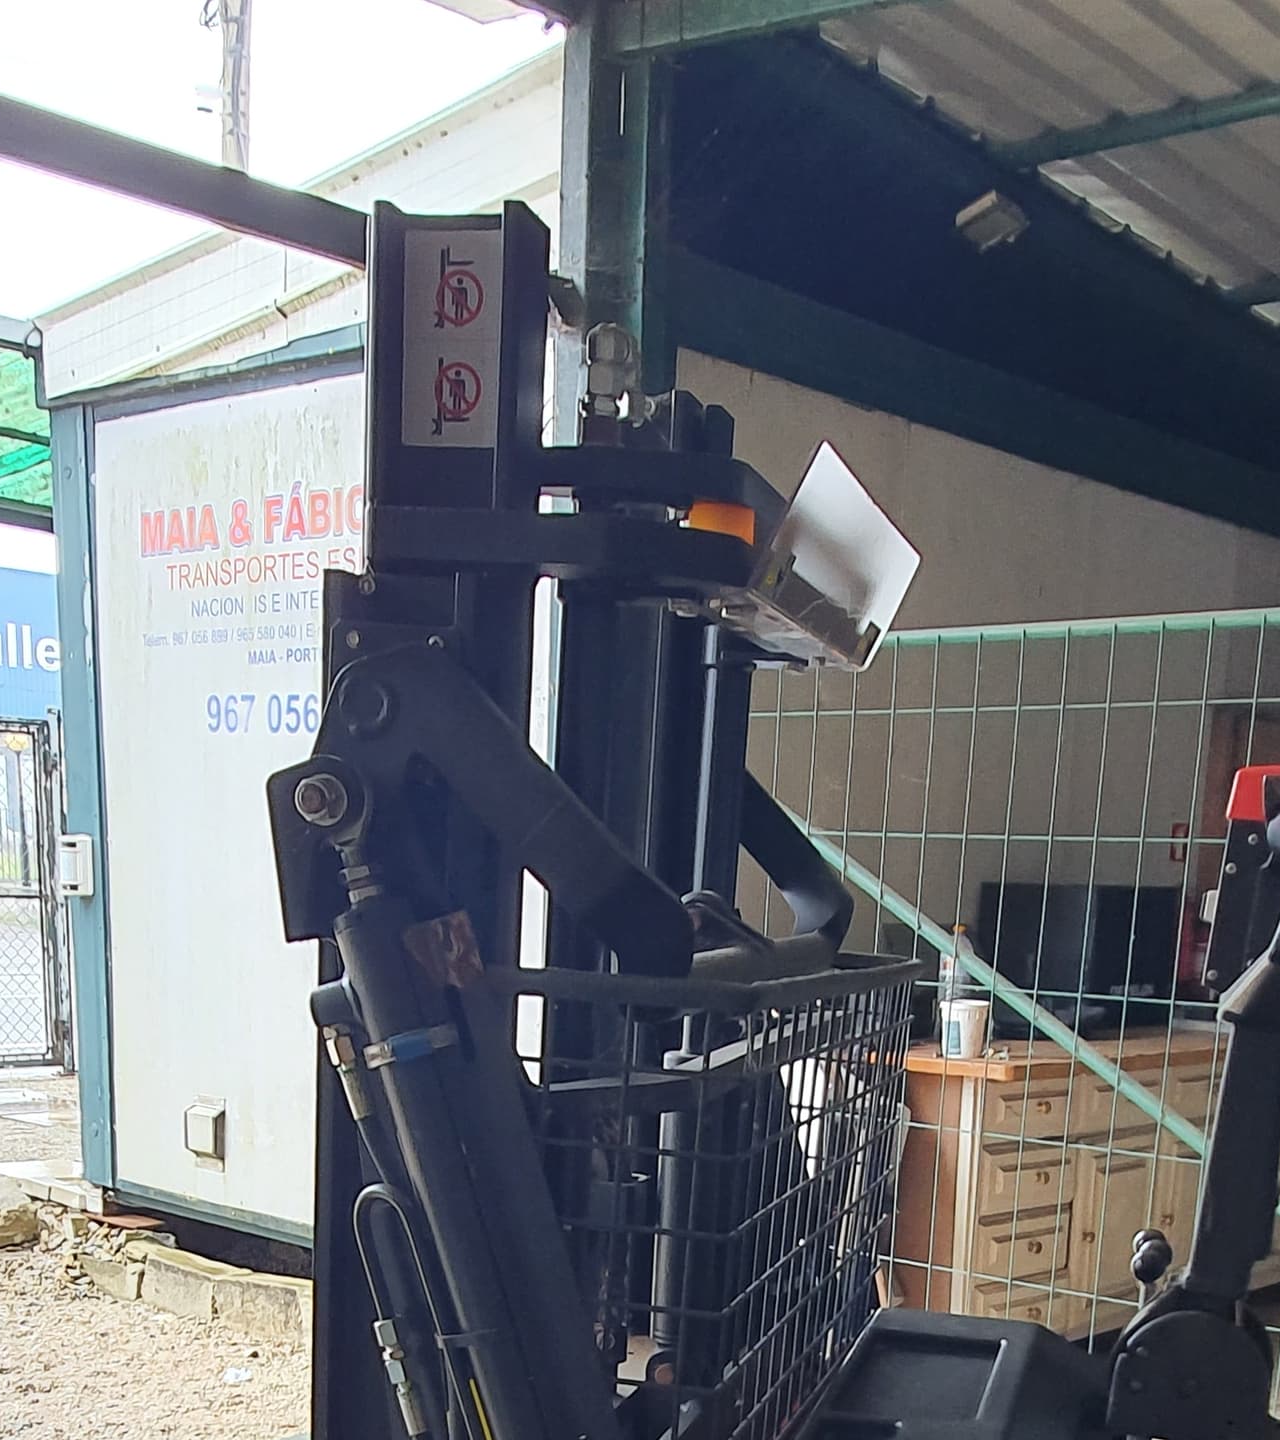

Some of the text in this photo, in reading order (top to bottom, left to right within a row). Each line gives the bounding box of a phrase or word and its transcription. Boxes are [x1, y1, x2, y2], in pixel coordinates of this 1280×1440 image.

[140, 504, 220, 557] MAIA
[229, 499, 252, 548] &
[166, 550, 320, 591] TRANSPORTES
[247, 648, 278, 665] MAIA
[206, 693, 320, 733] 967 056
